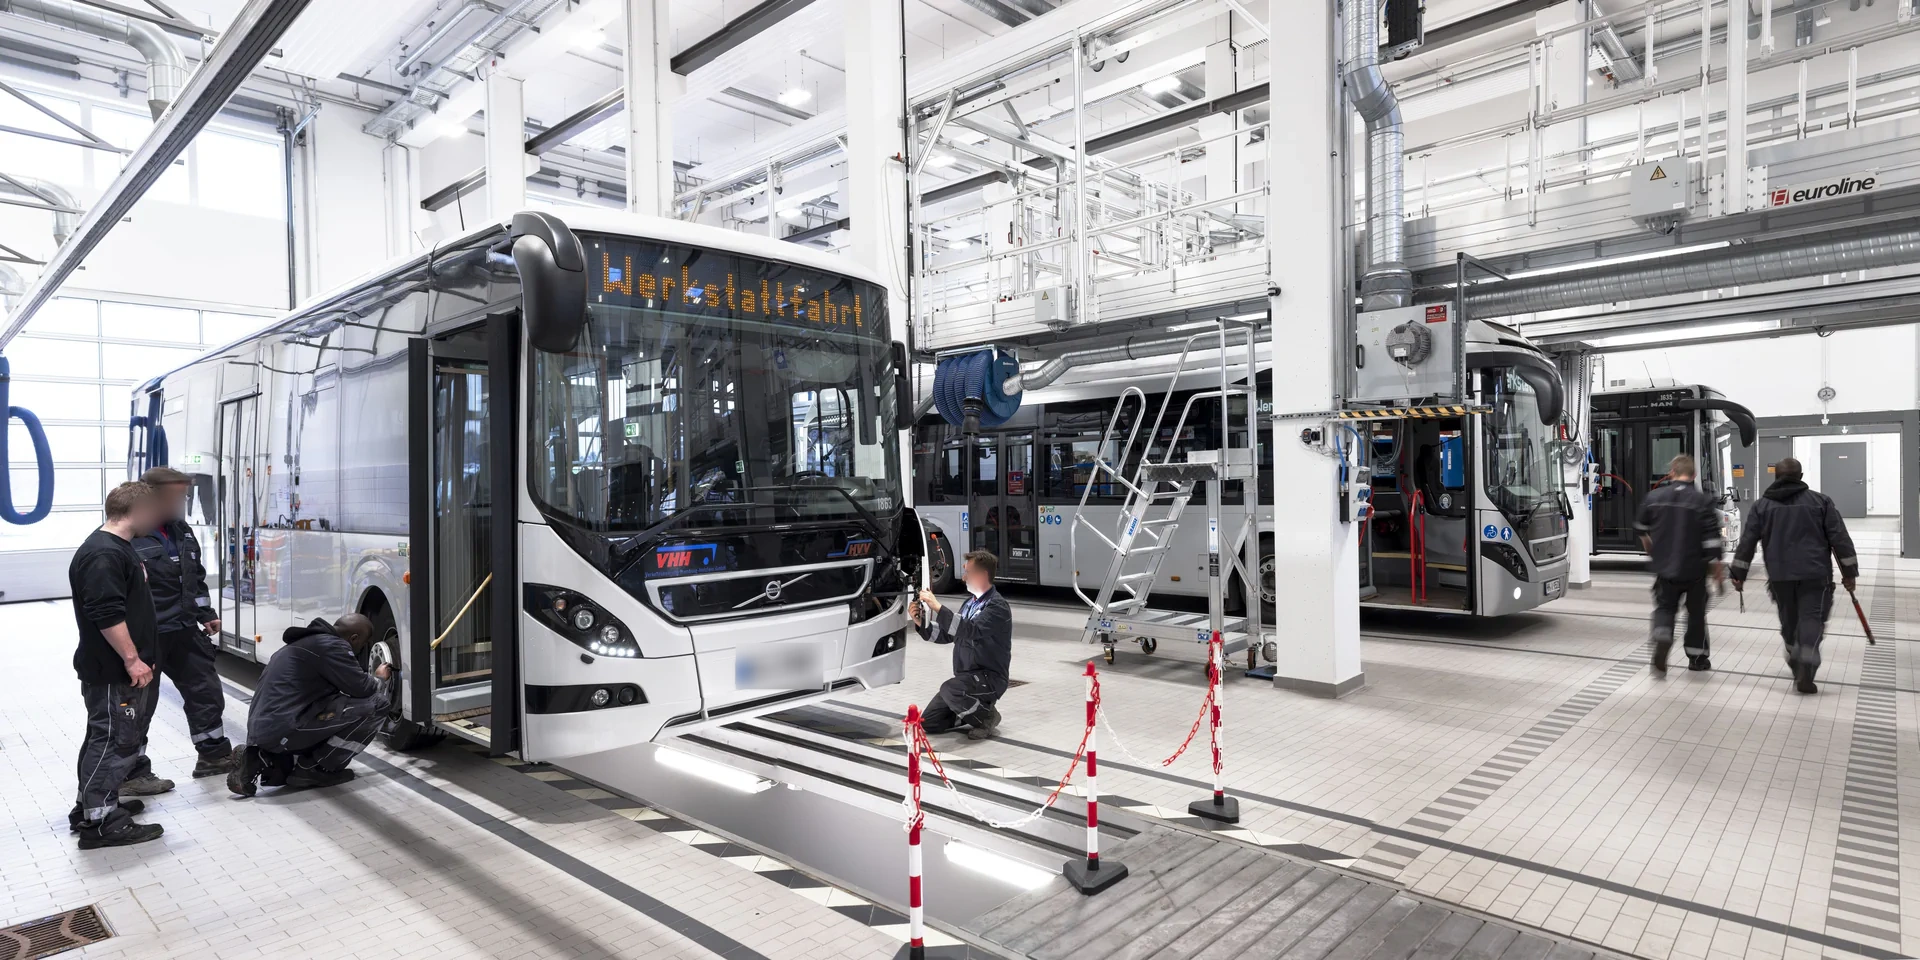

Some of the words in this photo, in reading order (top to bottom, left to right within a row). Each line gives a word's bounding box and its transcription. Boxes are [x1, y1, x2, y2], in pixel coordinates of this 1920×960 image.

[1793, 177, 1875, 202] euroline
[603, 252, 862, 327] Werkstattfahrt
[877, 497, 892, 510] 1863
[848, 543, 871, 556] HVV
[656, 551, 692, 568] VHH
